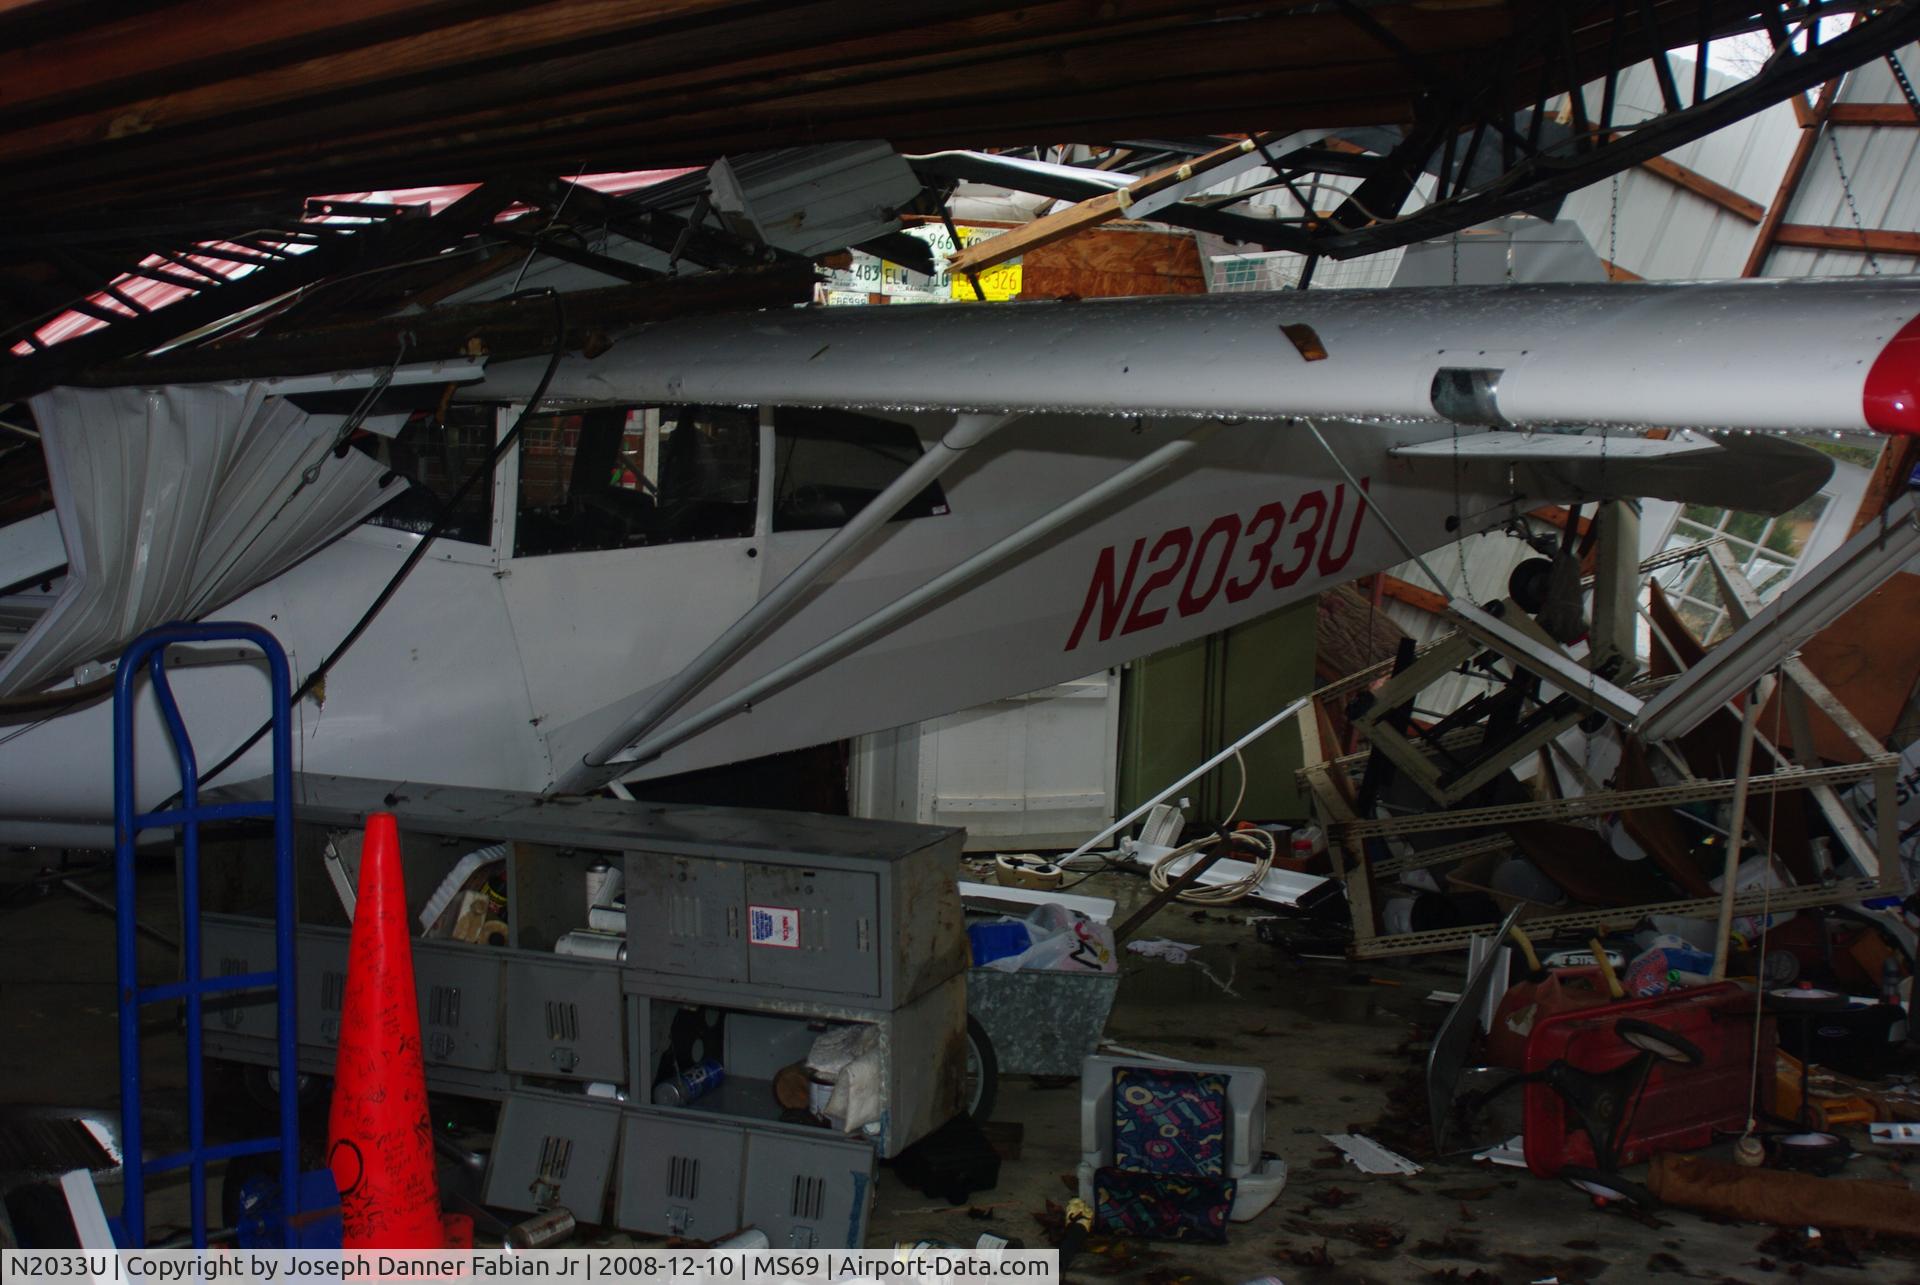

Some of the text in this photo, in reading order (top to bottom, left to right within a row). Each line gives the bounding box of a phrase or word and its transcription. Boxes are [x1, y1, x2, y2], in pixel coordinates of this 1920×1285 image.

[929, 233, 953, 250] 966
[855, 264, 880, 281] 483
[885, 268, 909, 285] ELW
[992, 271, 1017, 290] 326
[1064, 476, 1371, 651] N2033U
